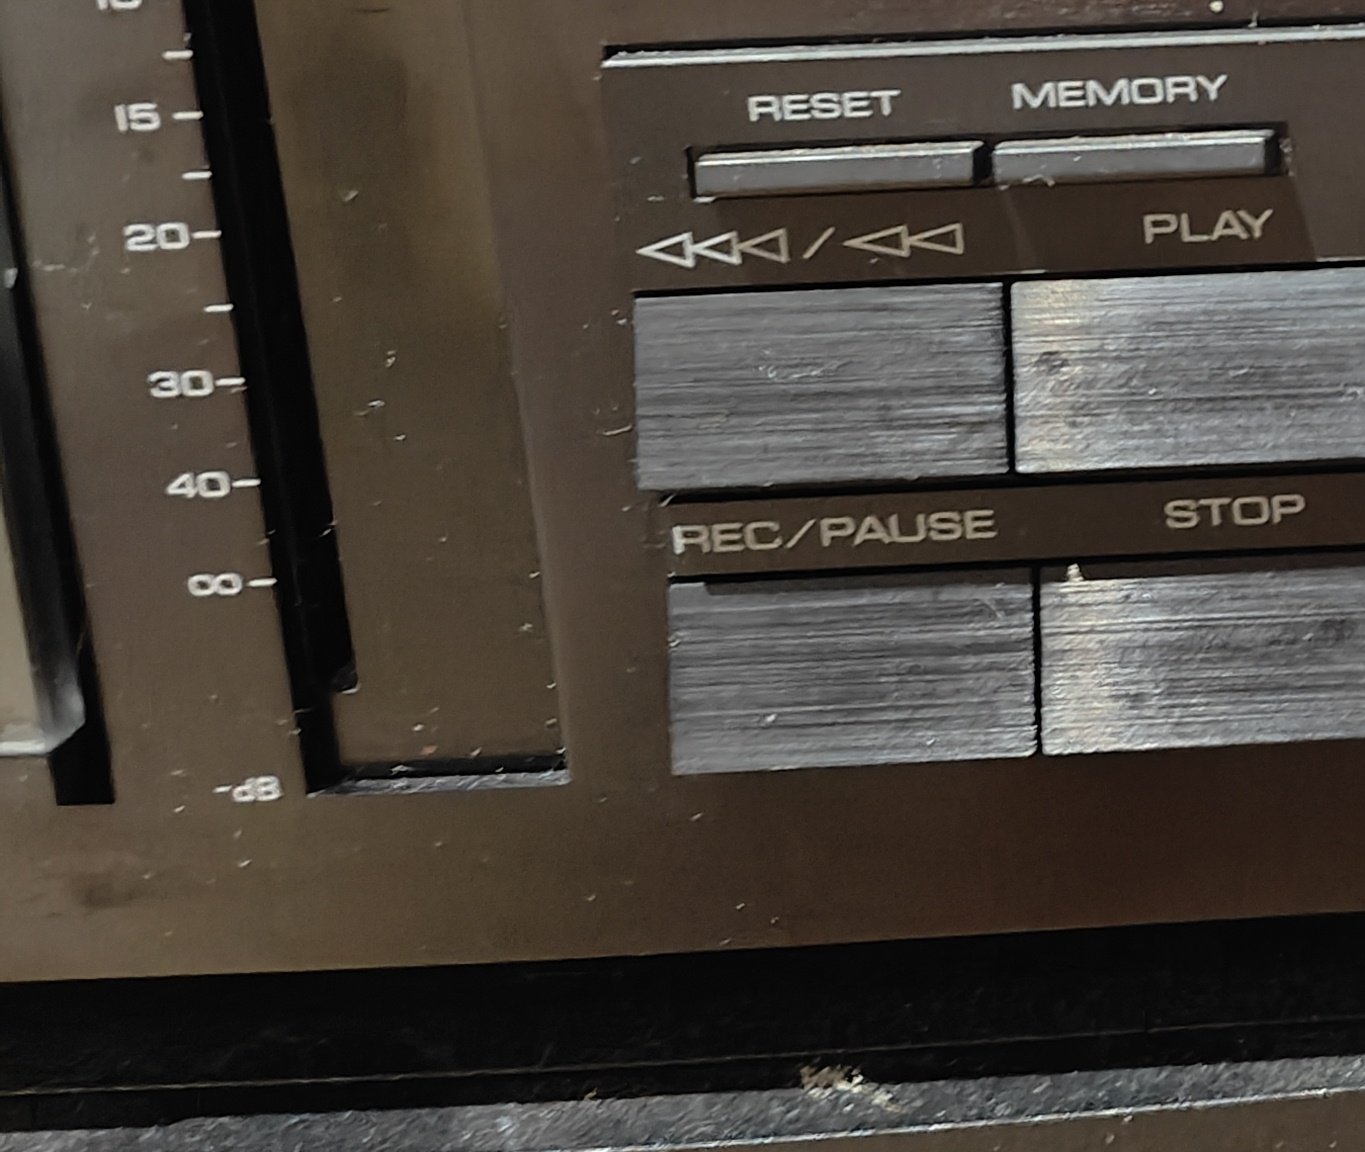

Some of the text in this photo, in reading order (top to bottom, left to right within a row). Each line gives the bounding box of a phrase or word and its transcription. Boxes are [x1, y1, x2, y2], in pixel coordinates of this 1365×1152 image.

[747, 89, 902, 124] RESET
[1011, 73, 1228, 110] MEMORY
[115, 103, 161, 132] 15
[124, 222, 191, 250] 20
[1143, 209, 1273, 244] PLAY
[148, 370, 214, 398] 30
[166, 472, 231, 499] 40
[1164, 494, 1305, 531] STOP
[673, 507, 997, 555] REC/PAUSE
